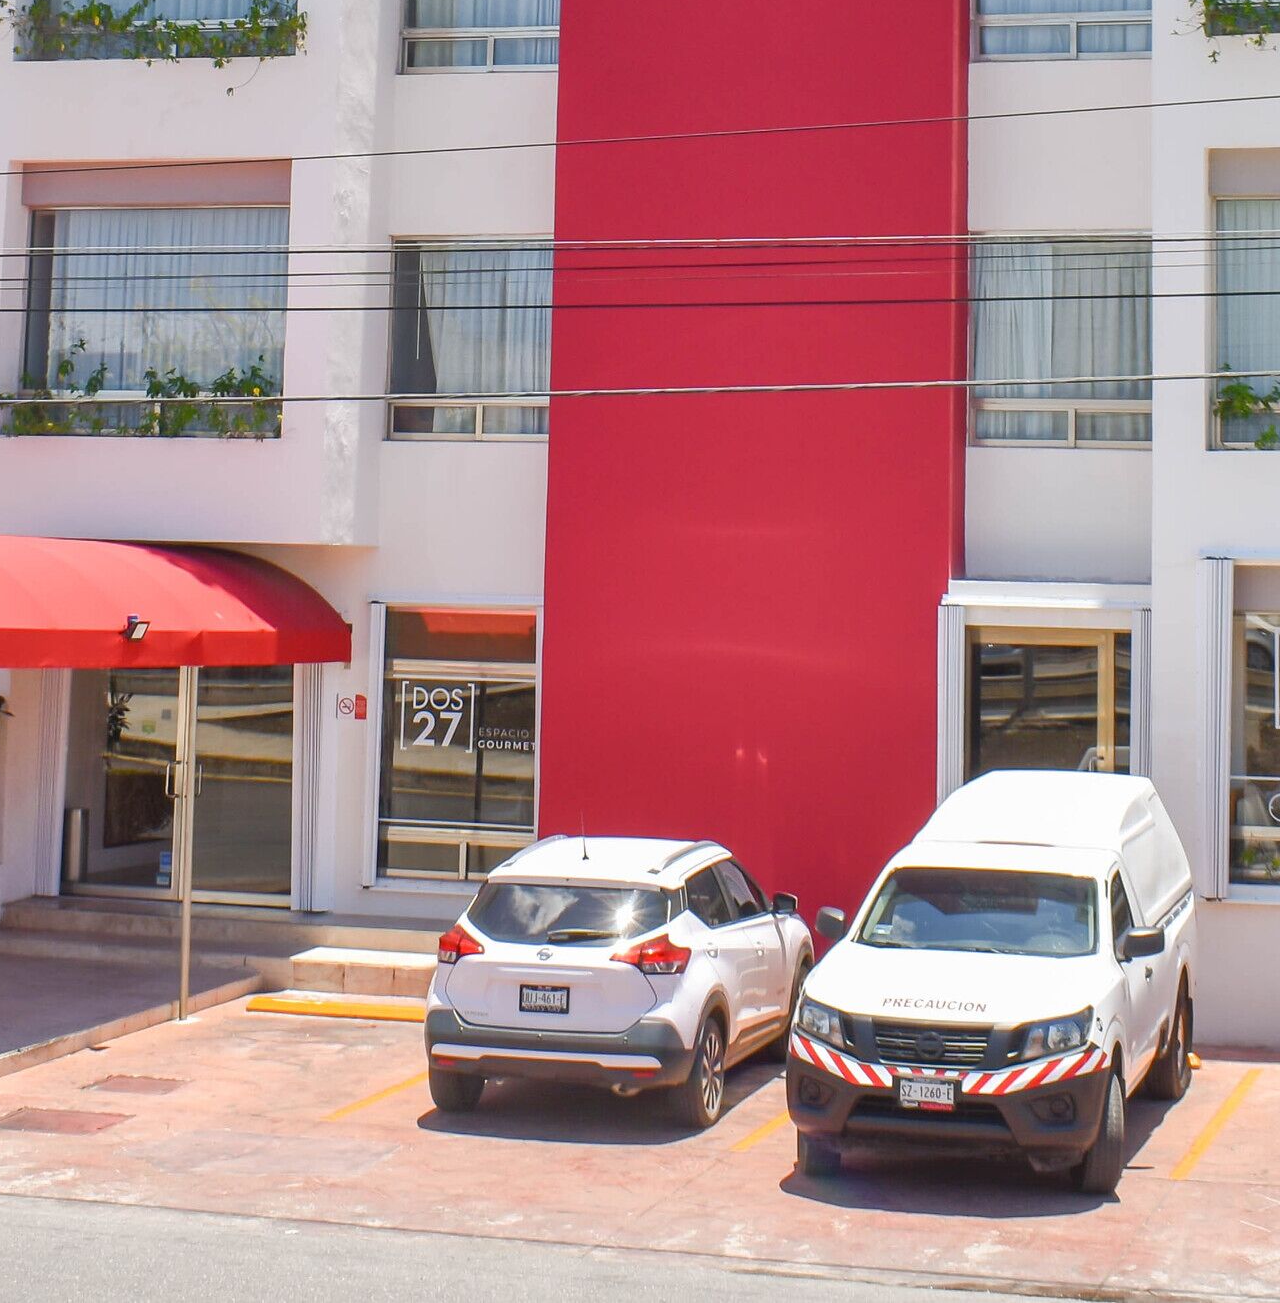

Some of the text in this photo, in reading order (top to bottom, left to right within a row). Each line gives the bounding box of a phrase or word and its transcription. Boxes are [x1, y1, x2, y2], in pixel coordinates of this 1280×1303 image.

[412, 686, 464, 711] DOS
[412, 710, 464, 747] 27
[478, 726, 530, 739] ESPACIO
[477, 739, 535, 751] GOURMET
[882, 998, 987, 1012] PRECAUCION
